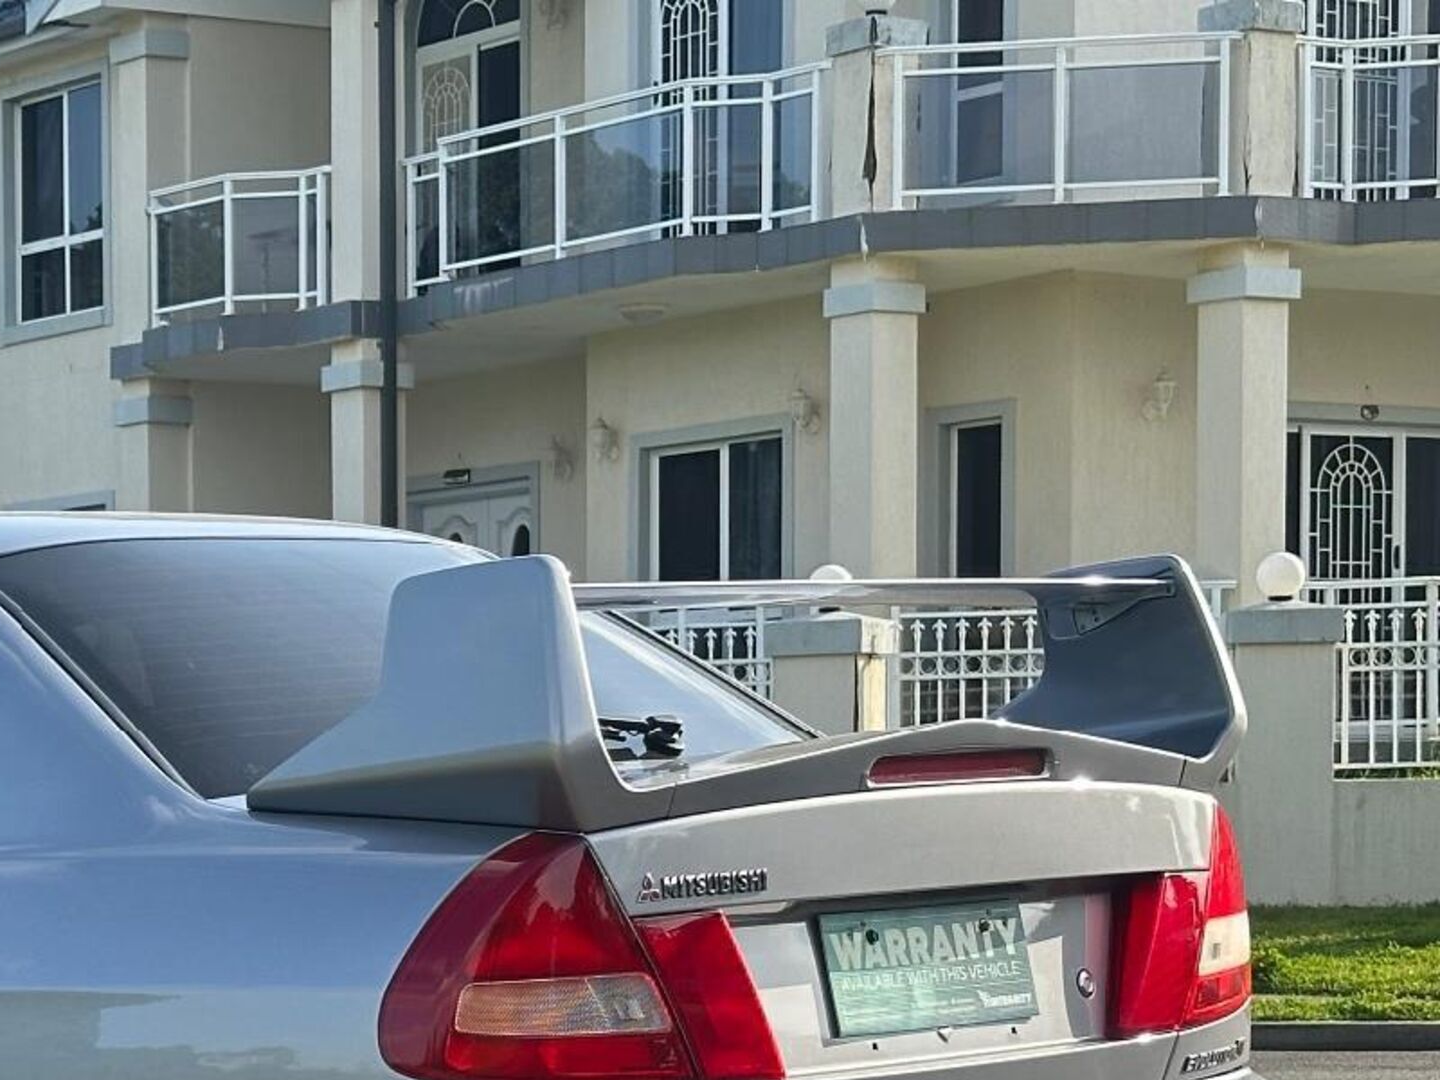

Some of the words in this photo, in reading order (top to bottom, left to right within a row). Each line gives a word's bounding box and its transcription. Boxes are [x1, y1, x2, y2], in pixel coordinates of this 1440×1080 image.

[660, 867, 768, 900] MITSUBISHI
[830, 916, 1018, 971] WARRANTY
[940, 965, 968, 981] THIS
[968, 960, 1022, 979] VEHICLE
